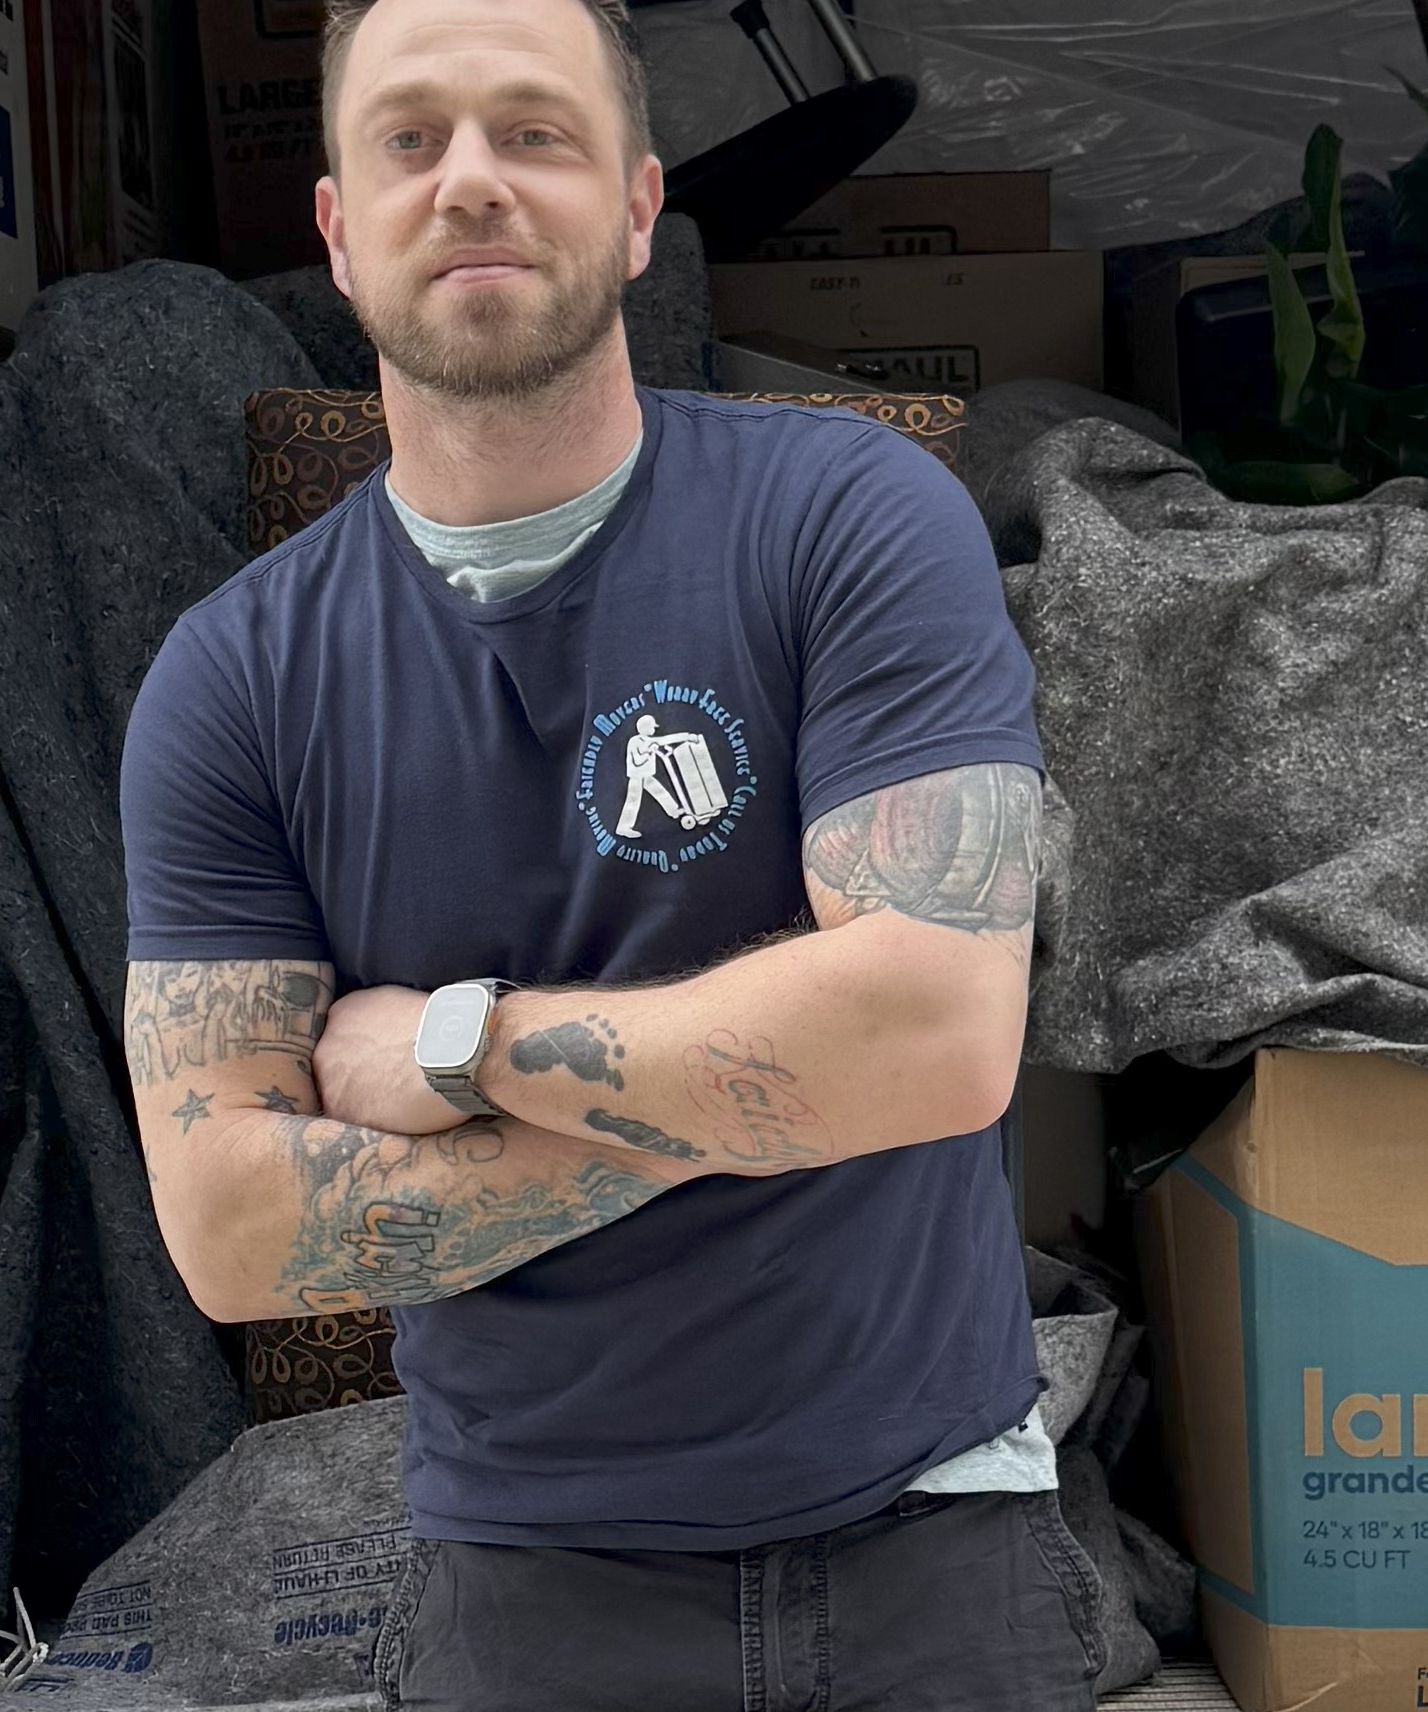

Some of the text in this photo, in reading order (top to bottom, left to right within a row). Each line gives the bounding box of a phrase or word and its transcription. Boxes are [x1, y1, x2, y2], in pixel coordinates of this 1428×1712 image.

[1303, 1521, 1338, 1540] 24"
[1341, 1526, 1353, 1540] x
[1358, 1521, 1390, 1540] 18"
[1393, 1526, 1405, 1540] x
[272, 1535, 397, 1570] PLEASE RETURN
[1303, 1549, 1412, 1570] 4.5 CU FT
[273, 1570, 339, 1594] U-HAUL
[346, 1566, 367, 1582] OF
[128, 1586, 152, 1603] NOT
[91, 1615, 119, 1633] PAD
[121, 1609, 151, 1627] THIS
